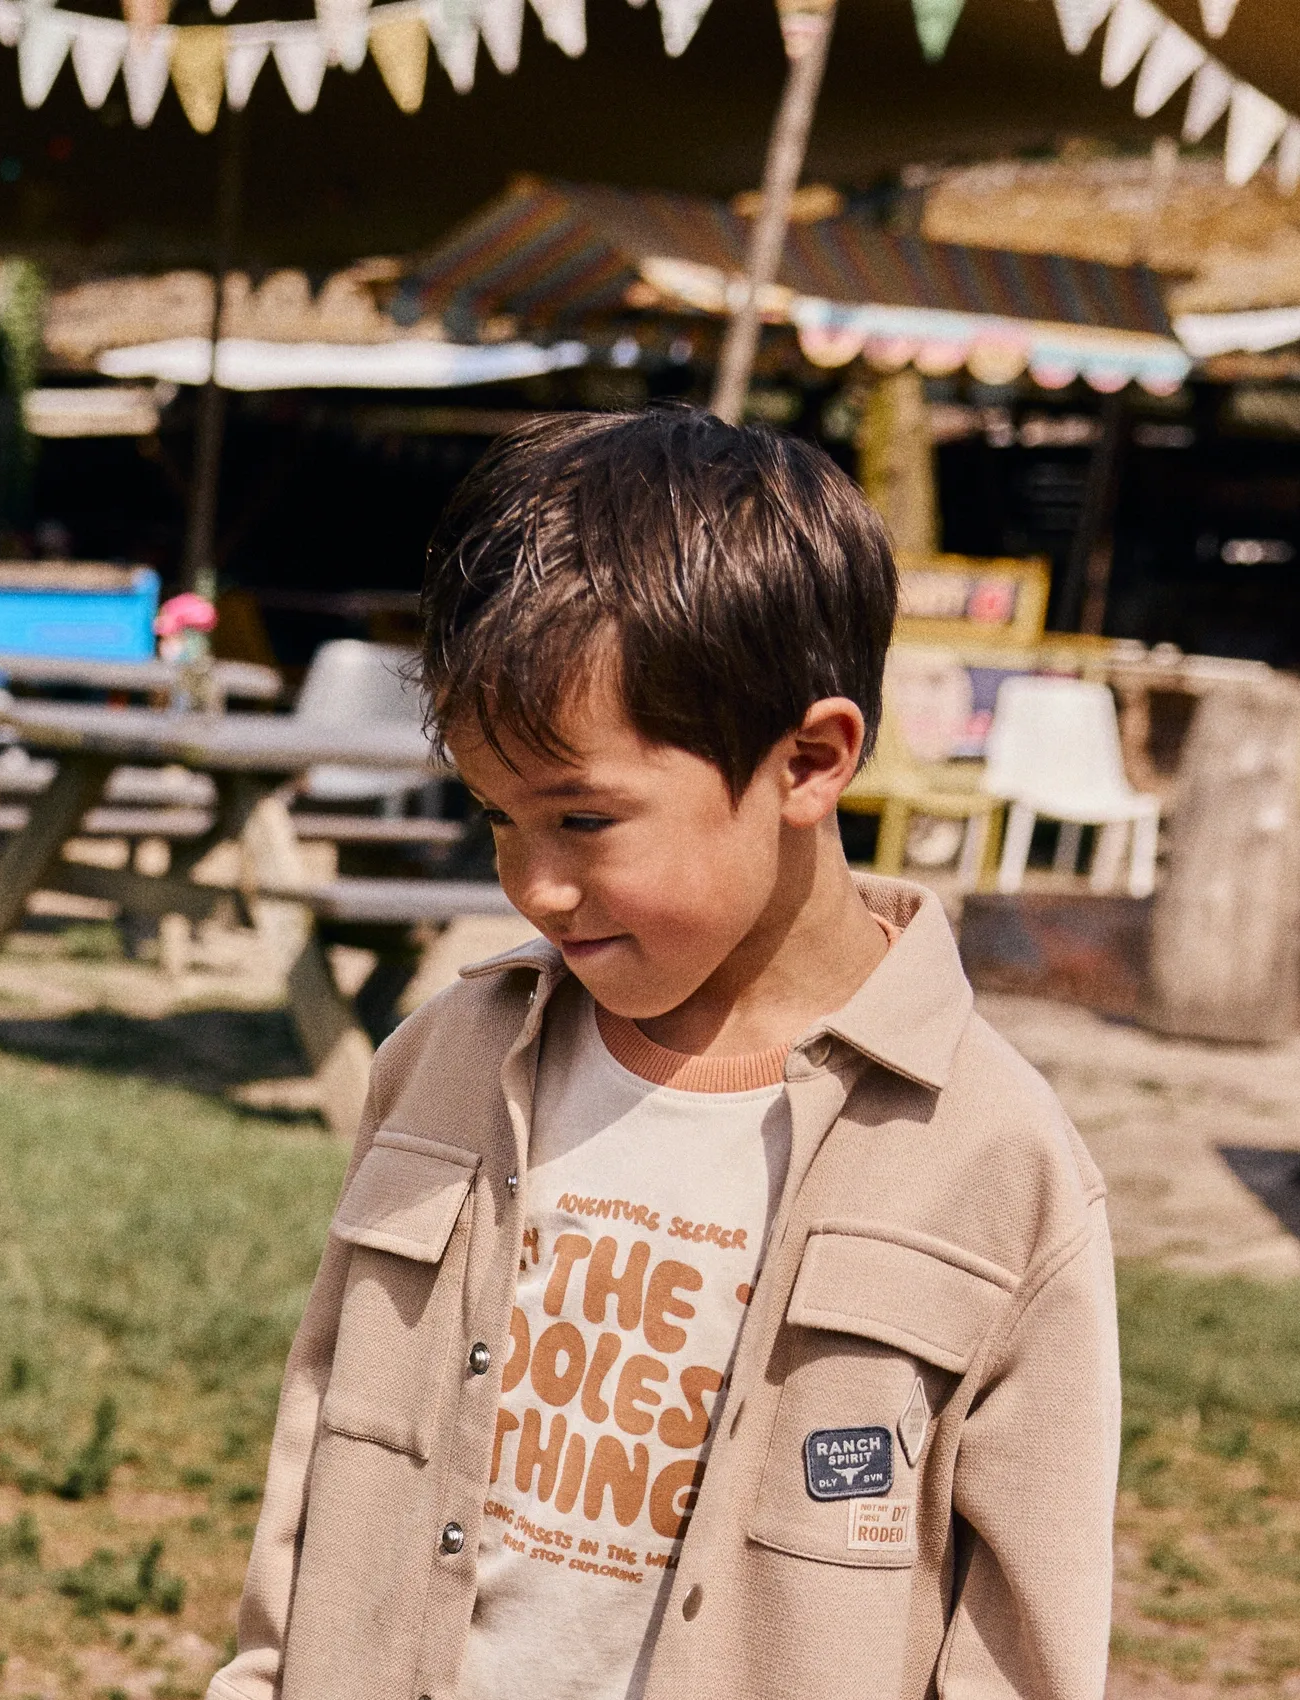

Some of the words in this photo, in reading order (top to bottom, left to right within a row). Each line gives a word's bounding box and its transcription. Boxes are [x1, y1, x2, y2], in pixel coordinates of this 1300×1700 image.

[556, 1192, 660, 1231] ADVENTURE
[667, 1216, 748, 1250] SEEKER
[542, 1233, 704, 1354] THE
[816, 1436, 881, 1456] RANCH
[828, 1451, 872, 1466] SPIRIT
[818, 1477, 838, 1488] DLY
[860, 1503, 876, 1511] NOT
[860, 1513, 880, 1522] FIRST
[484, 1500, 515, 1525] SING
[578, 1538, 599, 1557] IN
[607, 1544, 637, 1566] THE
[645, 1551, 680, 1570] WIL
[858, 1525, 903, 1542] RODEO
[529, 1547, 565, 1566] STOP
[568, 1558, 644, 1584] EXPLORING
